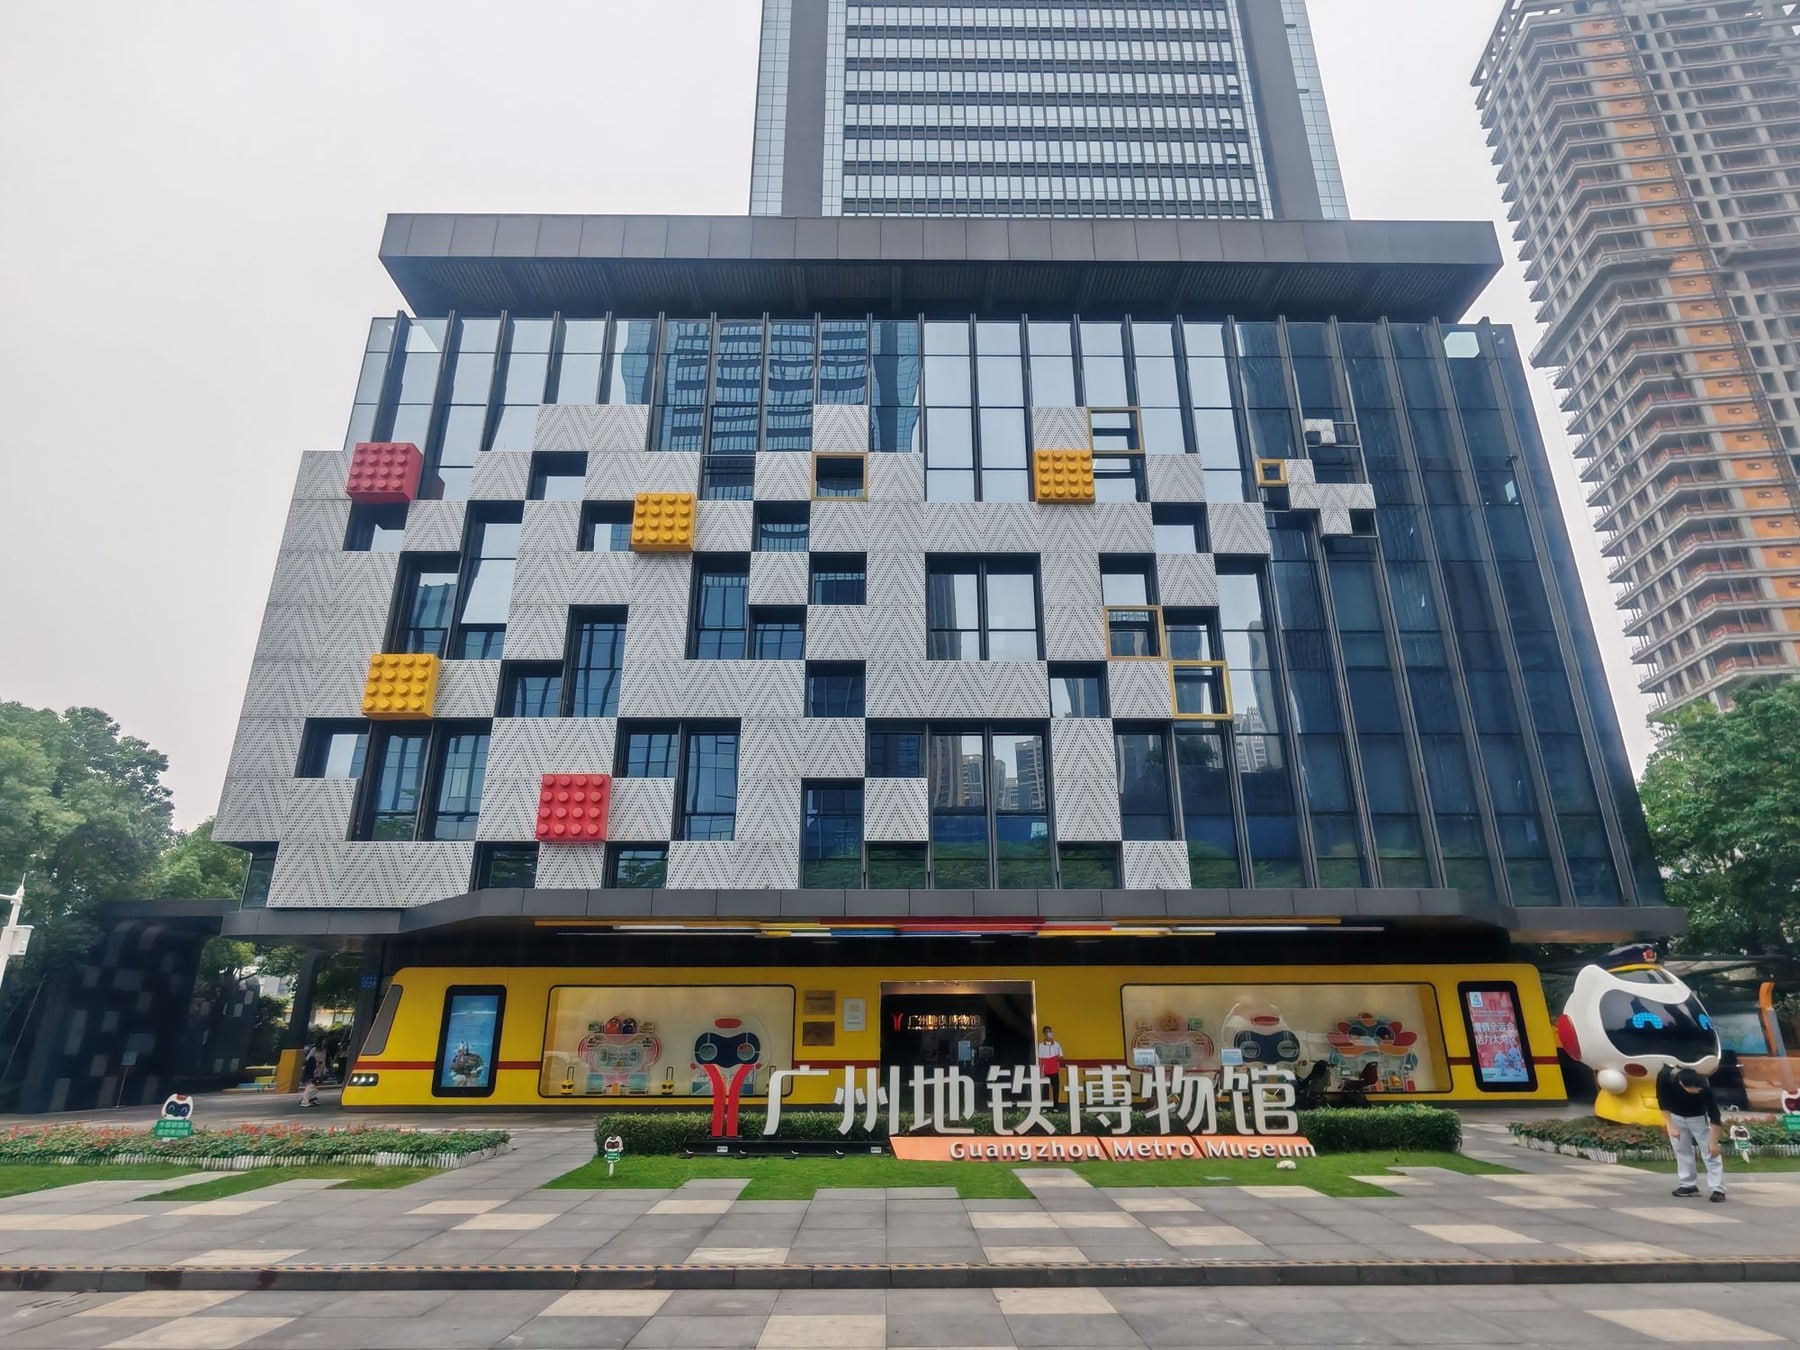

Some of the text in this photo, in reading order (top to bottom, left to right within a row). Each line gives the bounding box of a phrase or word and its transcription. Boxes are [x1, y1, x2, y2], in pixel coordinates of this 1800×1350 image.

[907, 1014, 981, 1026] 广州地铁博物馆
[763, 1064, 1298, 1135] 广州地铁博物馆
[950, 1139, 1317, 1160] Guangzhou Metro Museum
